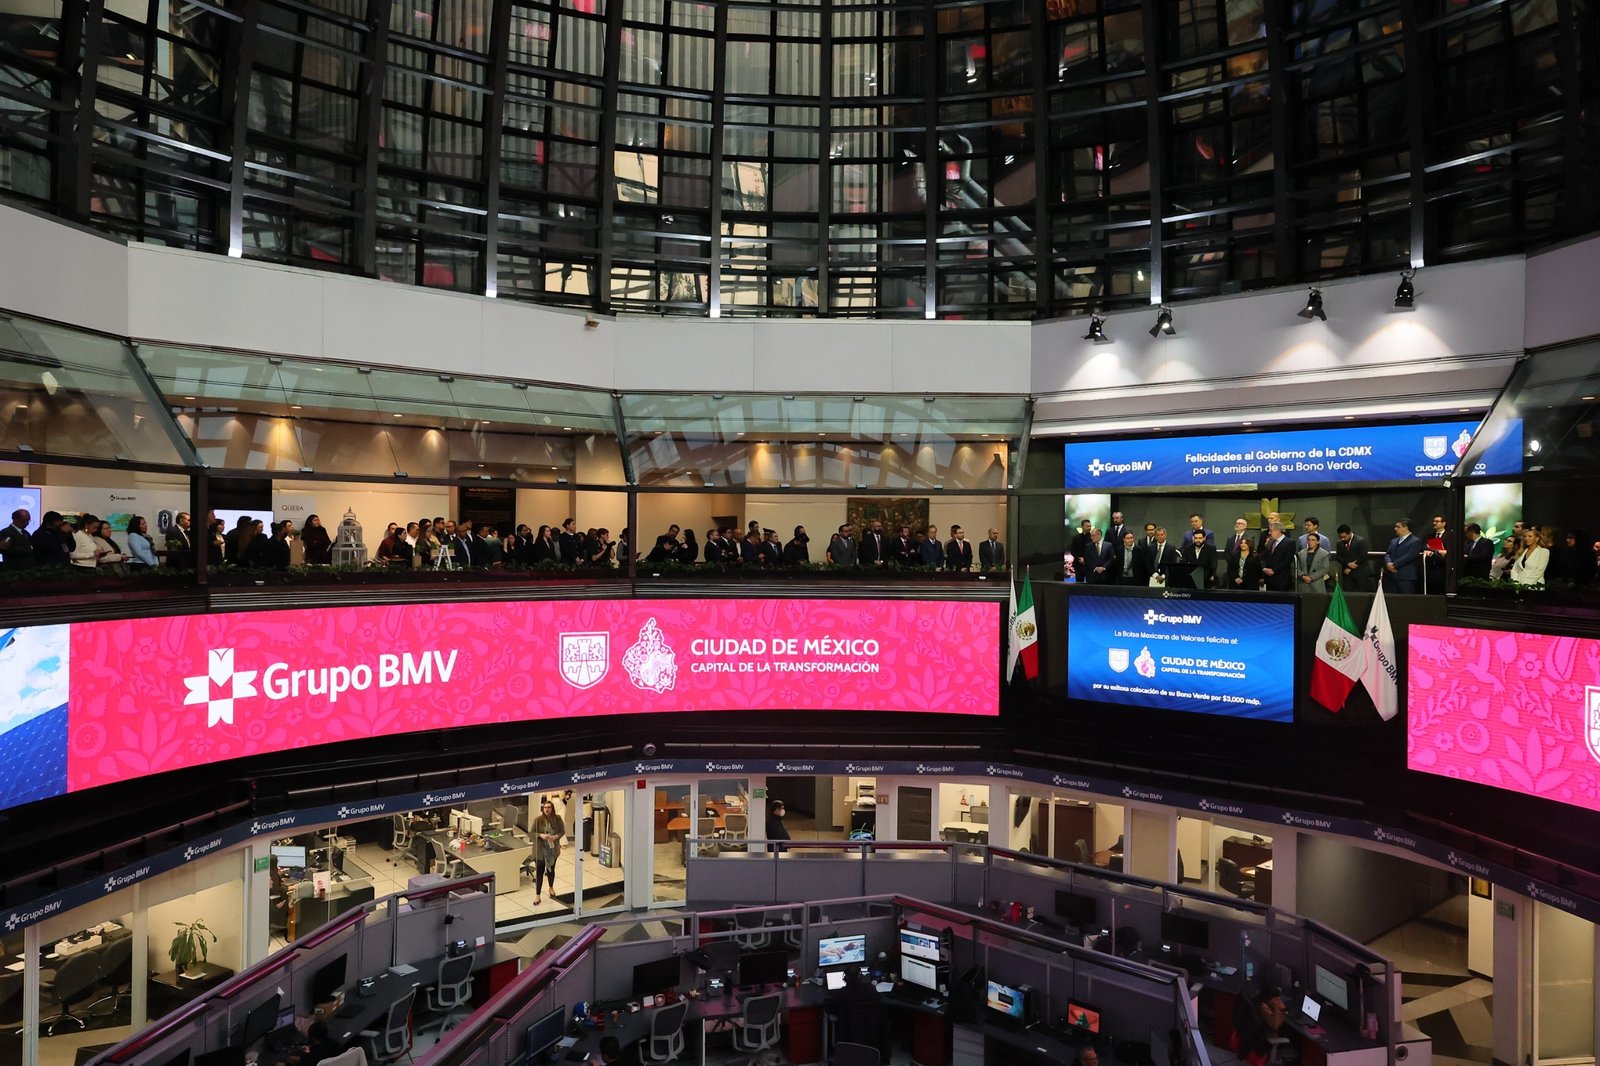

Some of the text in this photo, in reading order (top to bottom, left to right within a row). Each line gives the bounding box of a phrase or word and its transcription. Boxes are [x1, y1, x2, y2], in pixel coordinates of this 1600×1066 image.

[1186, 446, 1372, 463] Felicidades al Gobierno de la CDMX
[1105, 461, 1152, 474] Grupo BMV
[1193, 460, 1362, 476] por la emisión de su Bono Verde.
[1158, 614, 1202, 624] Grupo BMV
[691, 634, 880, 657] CIUDAD DE MÉXICO
[1140, 632, 1170, 640] Mexicana
[1180, 634, 1206, 643] Valores
[1206, 636, 1230, 644] felicita
[1230, 637, 1238, 645] al:
[1373, 640, 1388, 667] Grupo
[691, 660, 880, 674] CAPITAL DE LA TRANSFORMACIÓN
[1161, 656, 1246, 671] CIUDAD DE MÉXICO
[262, 649, 458, 702] Grupo BMV
[1197, 670, 1246, 679] TRANSFORMACIÓN
[1110, 684, 1130, 692] exitosa
[1130, 685, 1159, 695] colocación
[1193, 692, 1210, 700] Verde
[1222, 694, 1244, 704] $3,000
[1246, 698, 1262, 706] mdp.
[1062, 778, 1078, 786] Grupo
[452, 792, 466, 800] BMV
[1132, 790, 1150, 798] Grupo
[350, 807, 370, 815] Grupo
[1210, 803, 1244, 814] Grupo BMV
[262, 816, 296, 830] Grupo BMV
[1294, 816, 1331, 828] Grupo BMV
[194, 838, 222, 855] Grupo BMV
[1386, 832, 1416, 848] Grupo BMV
[1458, 858, 1490, 876] Grupo BMV
[116, 866, 150, 885] Grupo BMV
[1540, 888, 1577, 910] Grupo BMV
[21, 900, 62, 922] Grupo BMV
